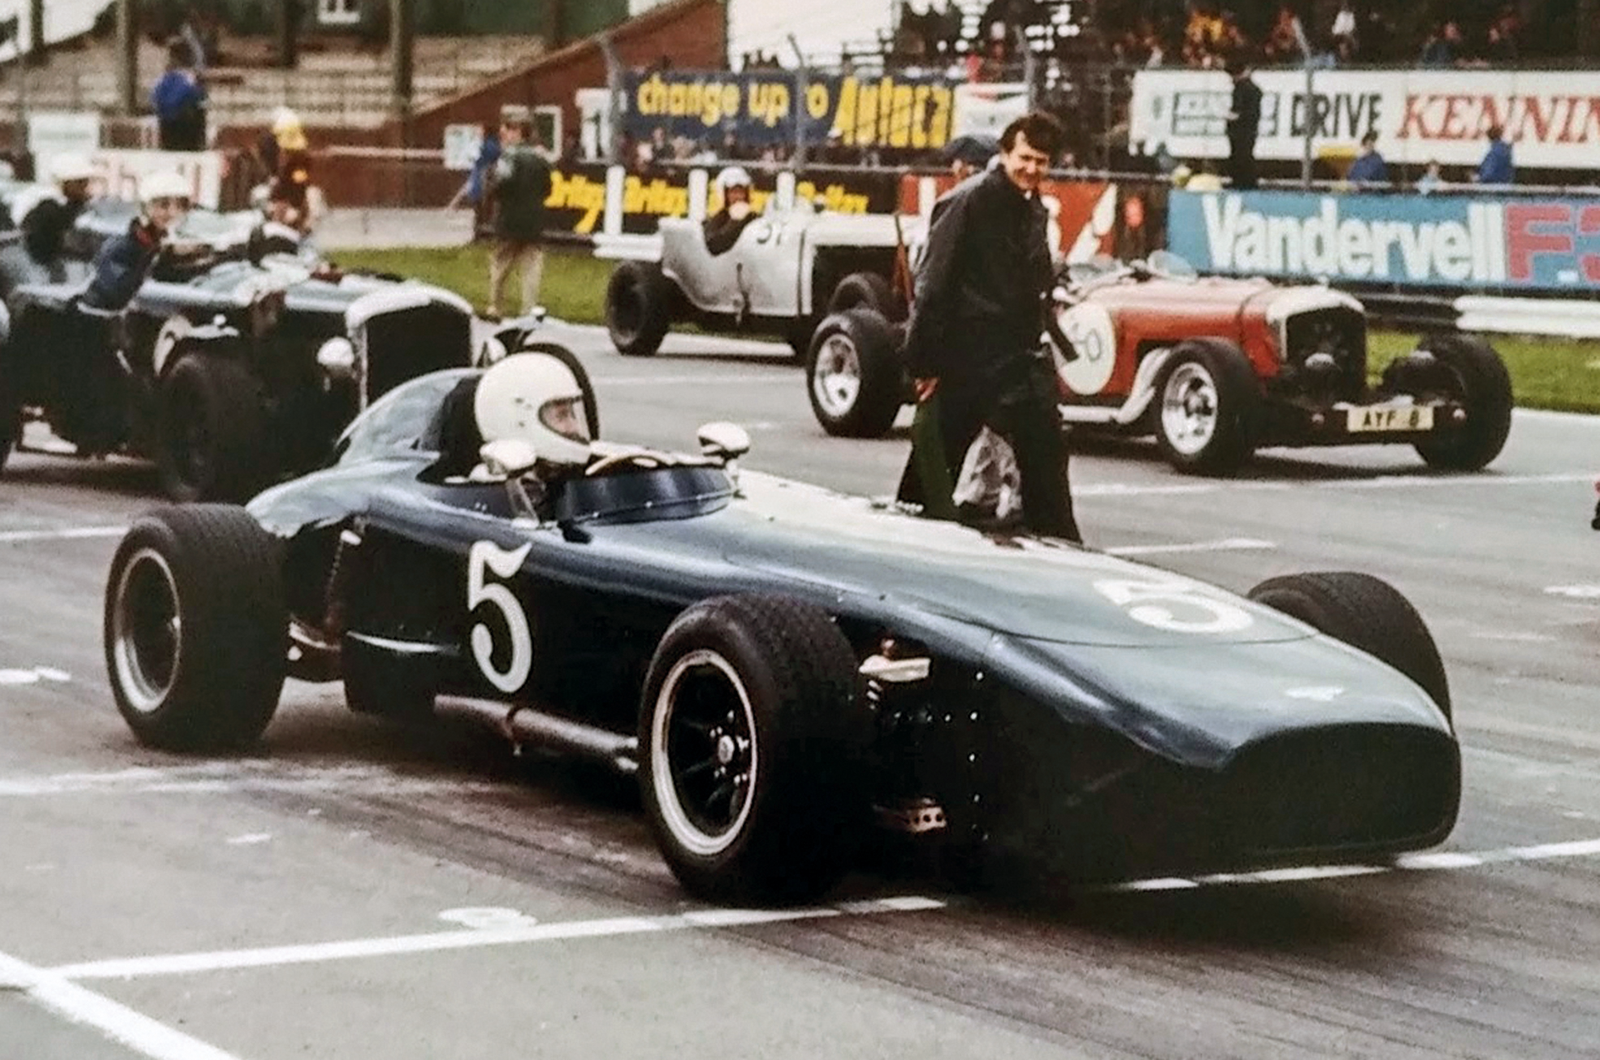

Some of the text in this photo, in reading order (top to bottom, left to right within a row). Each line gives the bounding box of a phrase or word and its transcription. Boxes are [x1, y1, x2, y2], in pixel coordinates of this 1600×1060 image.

[637, 73, 740, 127] change
[749, 82, 790, 128] up
[1290, 93, 1382, 139] DRIVE
[1202, 195, 1506, 281] Vandervell
[468, 540, 533, 693] 5
[1092, 579, 1254, 633] 5
